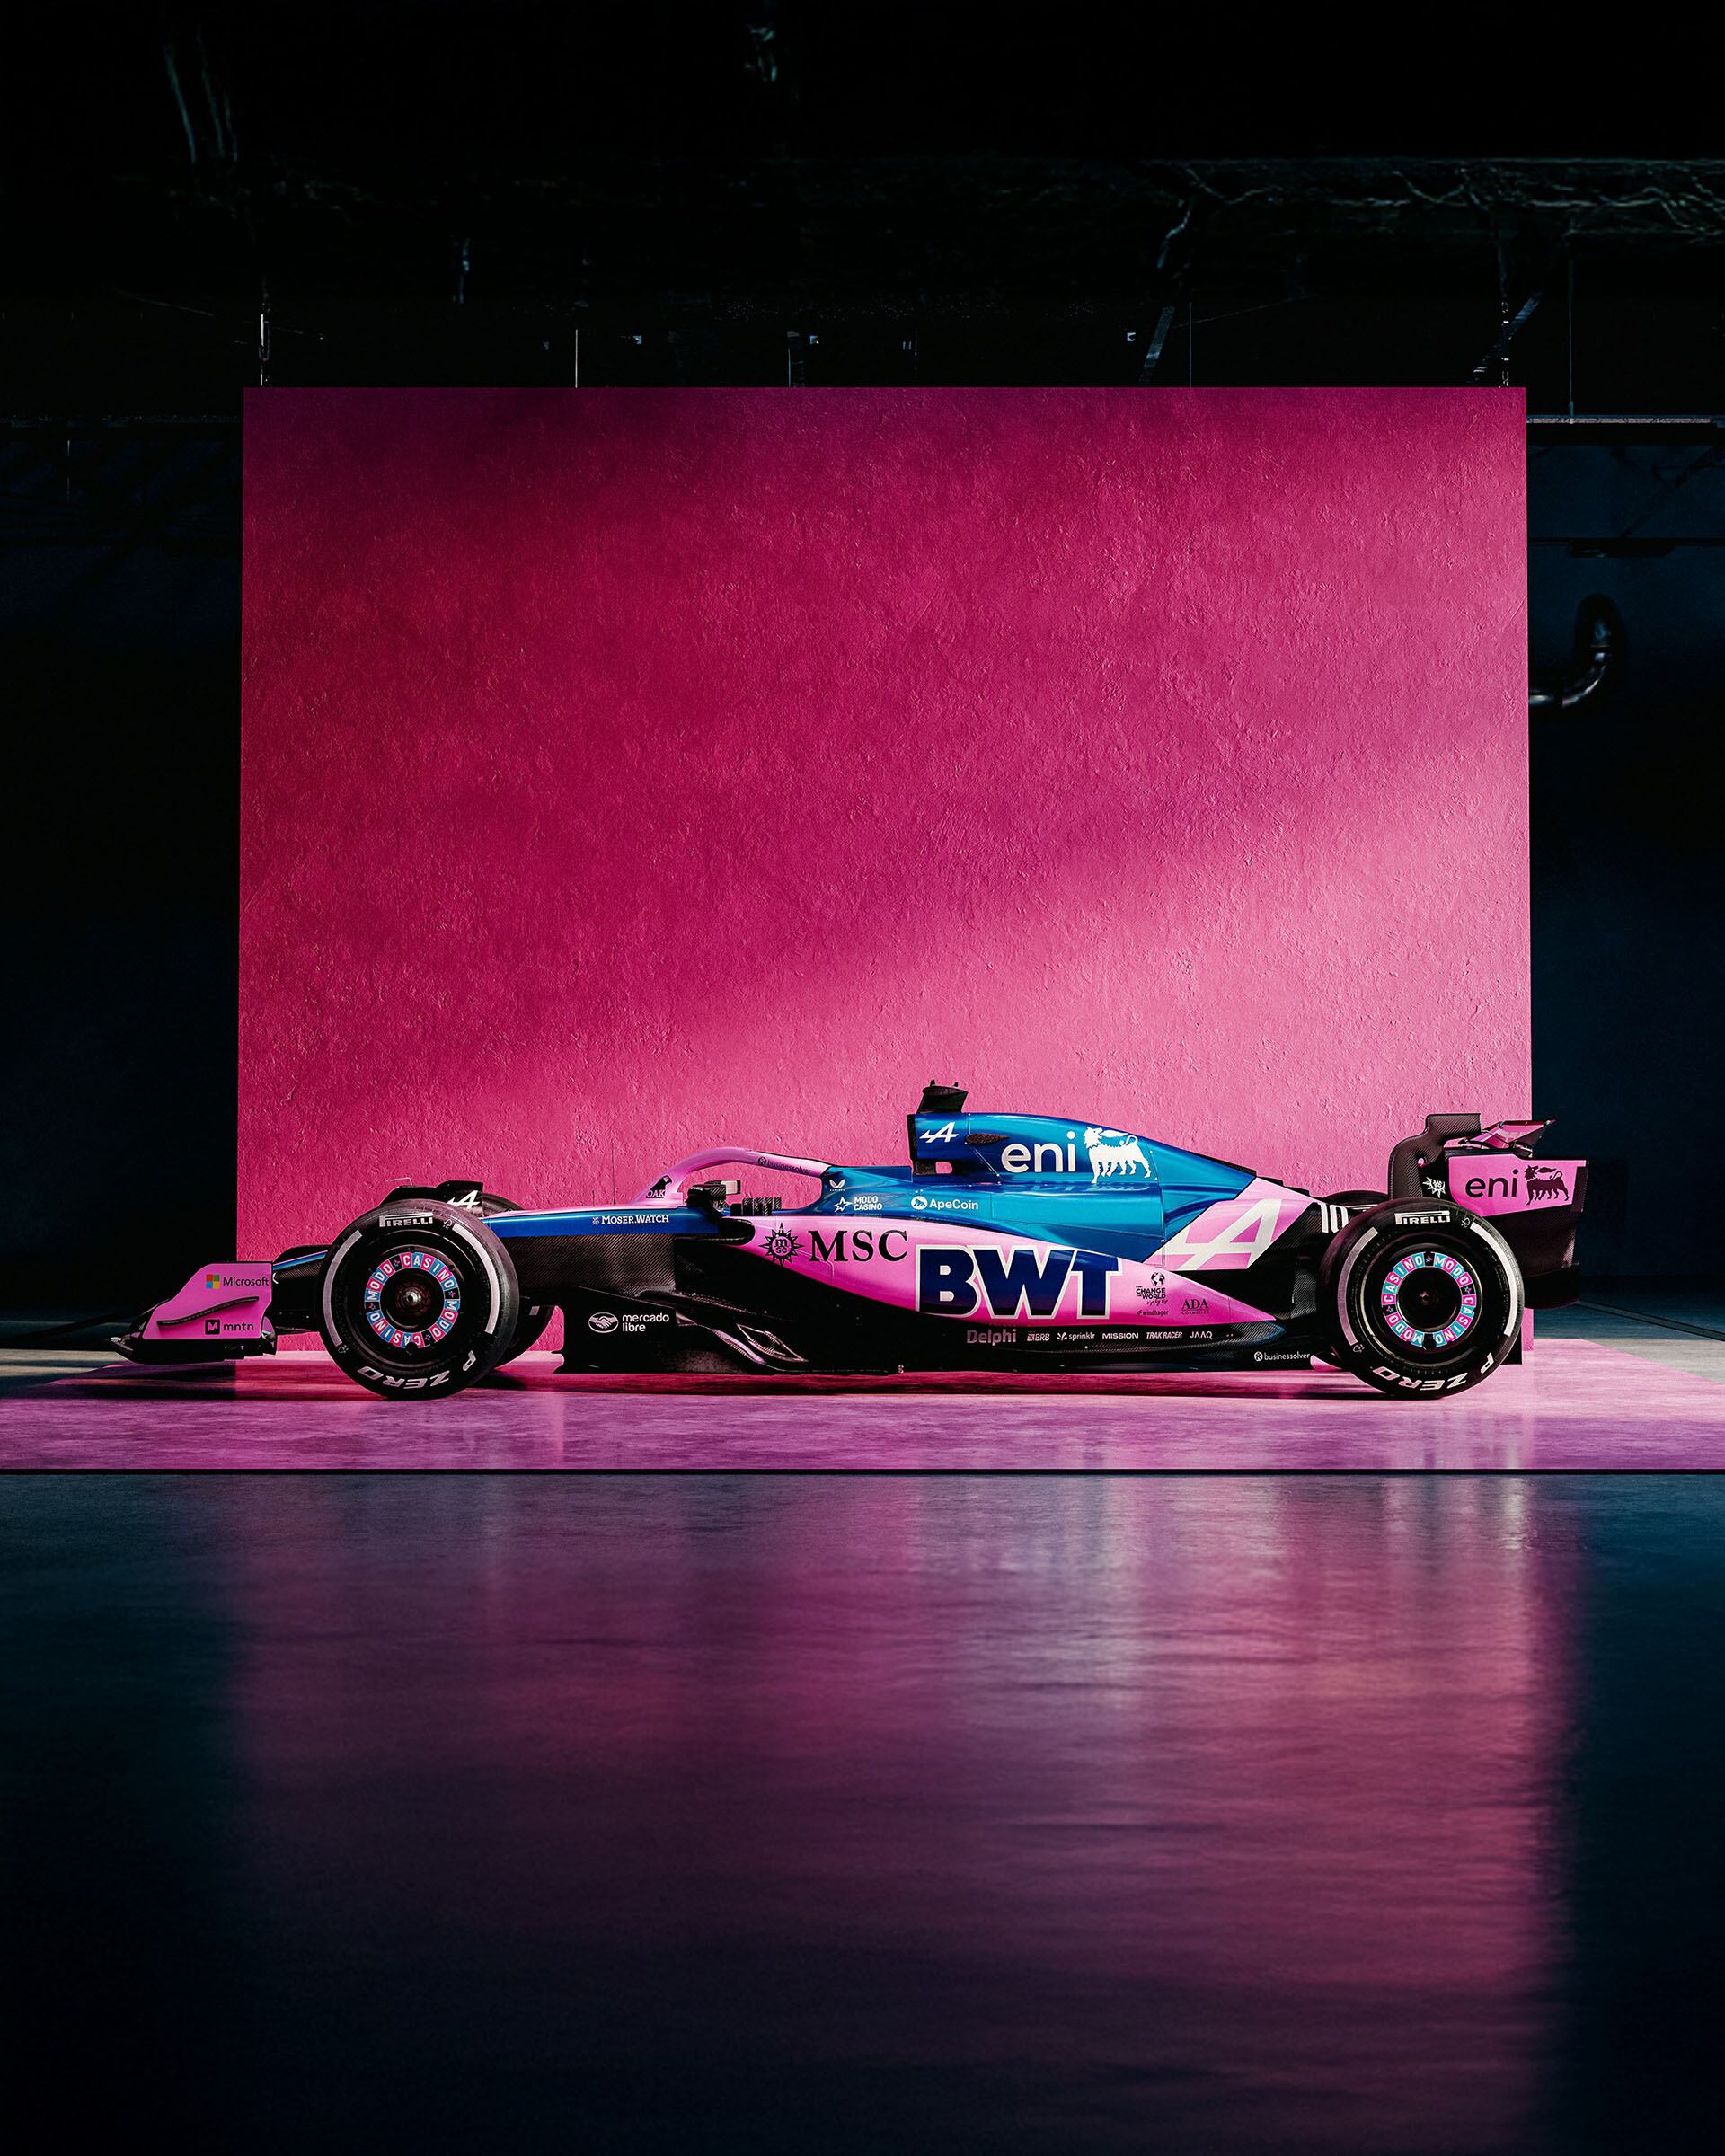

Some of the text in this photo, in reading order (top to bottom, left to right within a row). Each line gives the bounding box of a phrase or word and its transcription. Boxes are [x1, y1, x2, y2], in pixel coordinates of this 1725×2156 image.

[1001, 1131, 1076, 1173] eni
[1465, 1169, 1518, 1198] eni
[646, 1190, 666, 1198] OAK
[854, 1196, 879, 1204] MODO
[854, 1203, 883, 1211] CASINO
[929, 1199, 979, 1211] ApeCoin
[379, 1213, 434, 1228] PIRELLI
[1394, 1210, 1451, 1225] PIRELLI
[808, 1230, 908, 1262] MSC
[223, 1277, 269, 1286] Microsoft
[367, 1255, 455, 1301] MODO CASINO
[915, 1244, 1123, 1320] BWT
[1383, 1255, 1424, 1303] CASINO
[1434, 1256, 1470, 1286] MODO
[1181, 1298, 1209, 1309] ADA
[434, 1301, 458, 1339] MODO
[622, 1312, 670, 1322] mercado
[1437, 1296, 1474, 1345] CASINO
[223, 1321, 254, 1331] mntn
[622, 1322, 646, 1332] libre
[1389, 1314, 1423, 1346] MODO
[967, 1329, 1017, 1346] Delphi
[1068, 1331, 1096, 1341] sprinklr
[1146, 1331, 1183, 1339] TRAK RACER
[1263, 1351, 1311, 1361] businessolver
[358, 1365, 450, 1390] ZERO
[1372, 1366, 1469, 1392] ZERO
